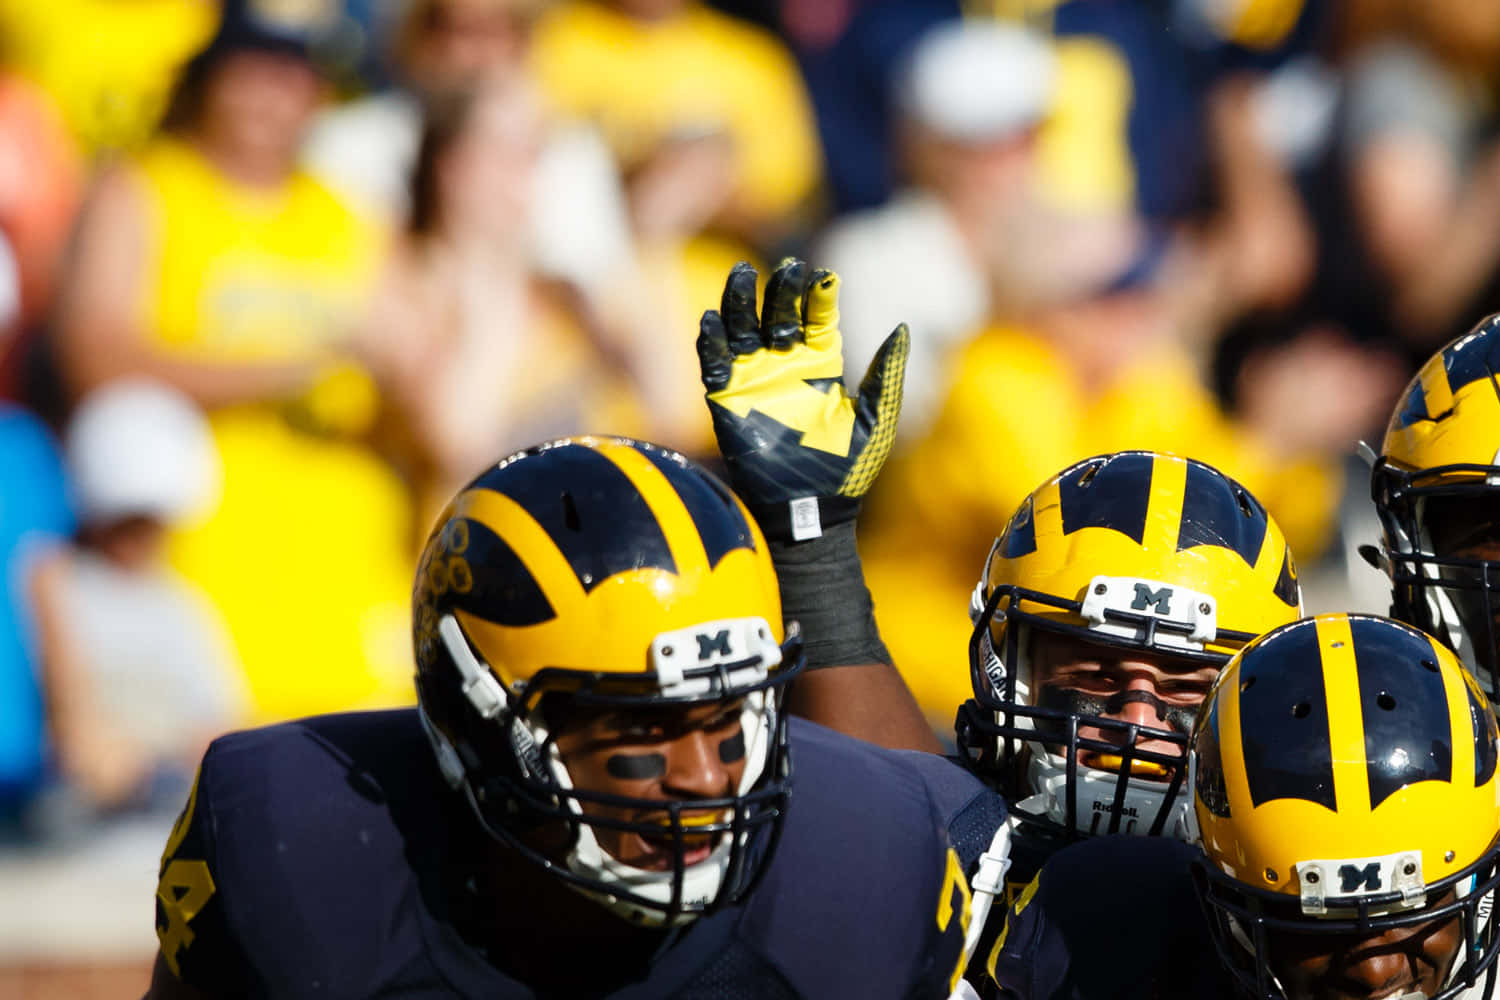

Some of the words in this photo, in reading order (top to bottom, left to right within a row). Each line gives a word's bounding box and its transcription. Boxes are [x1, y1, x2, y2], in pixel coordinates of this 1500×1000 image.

[1131, 583, 1174, 615] M
[696, 629, 733, 661] M
[1340, 862, 1382, 893] M
